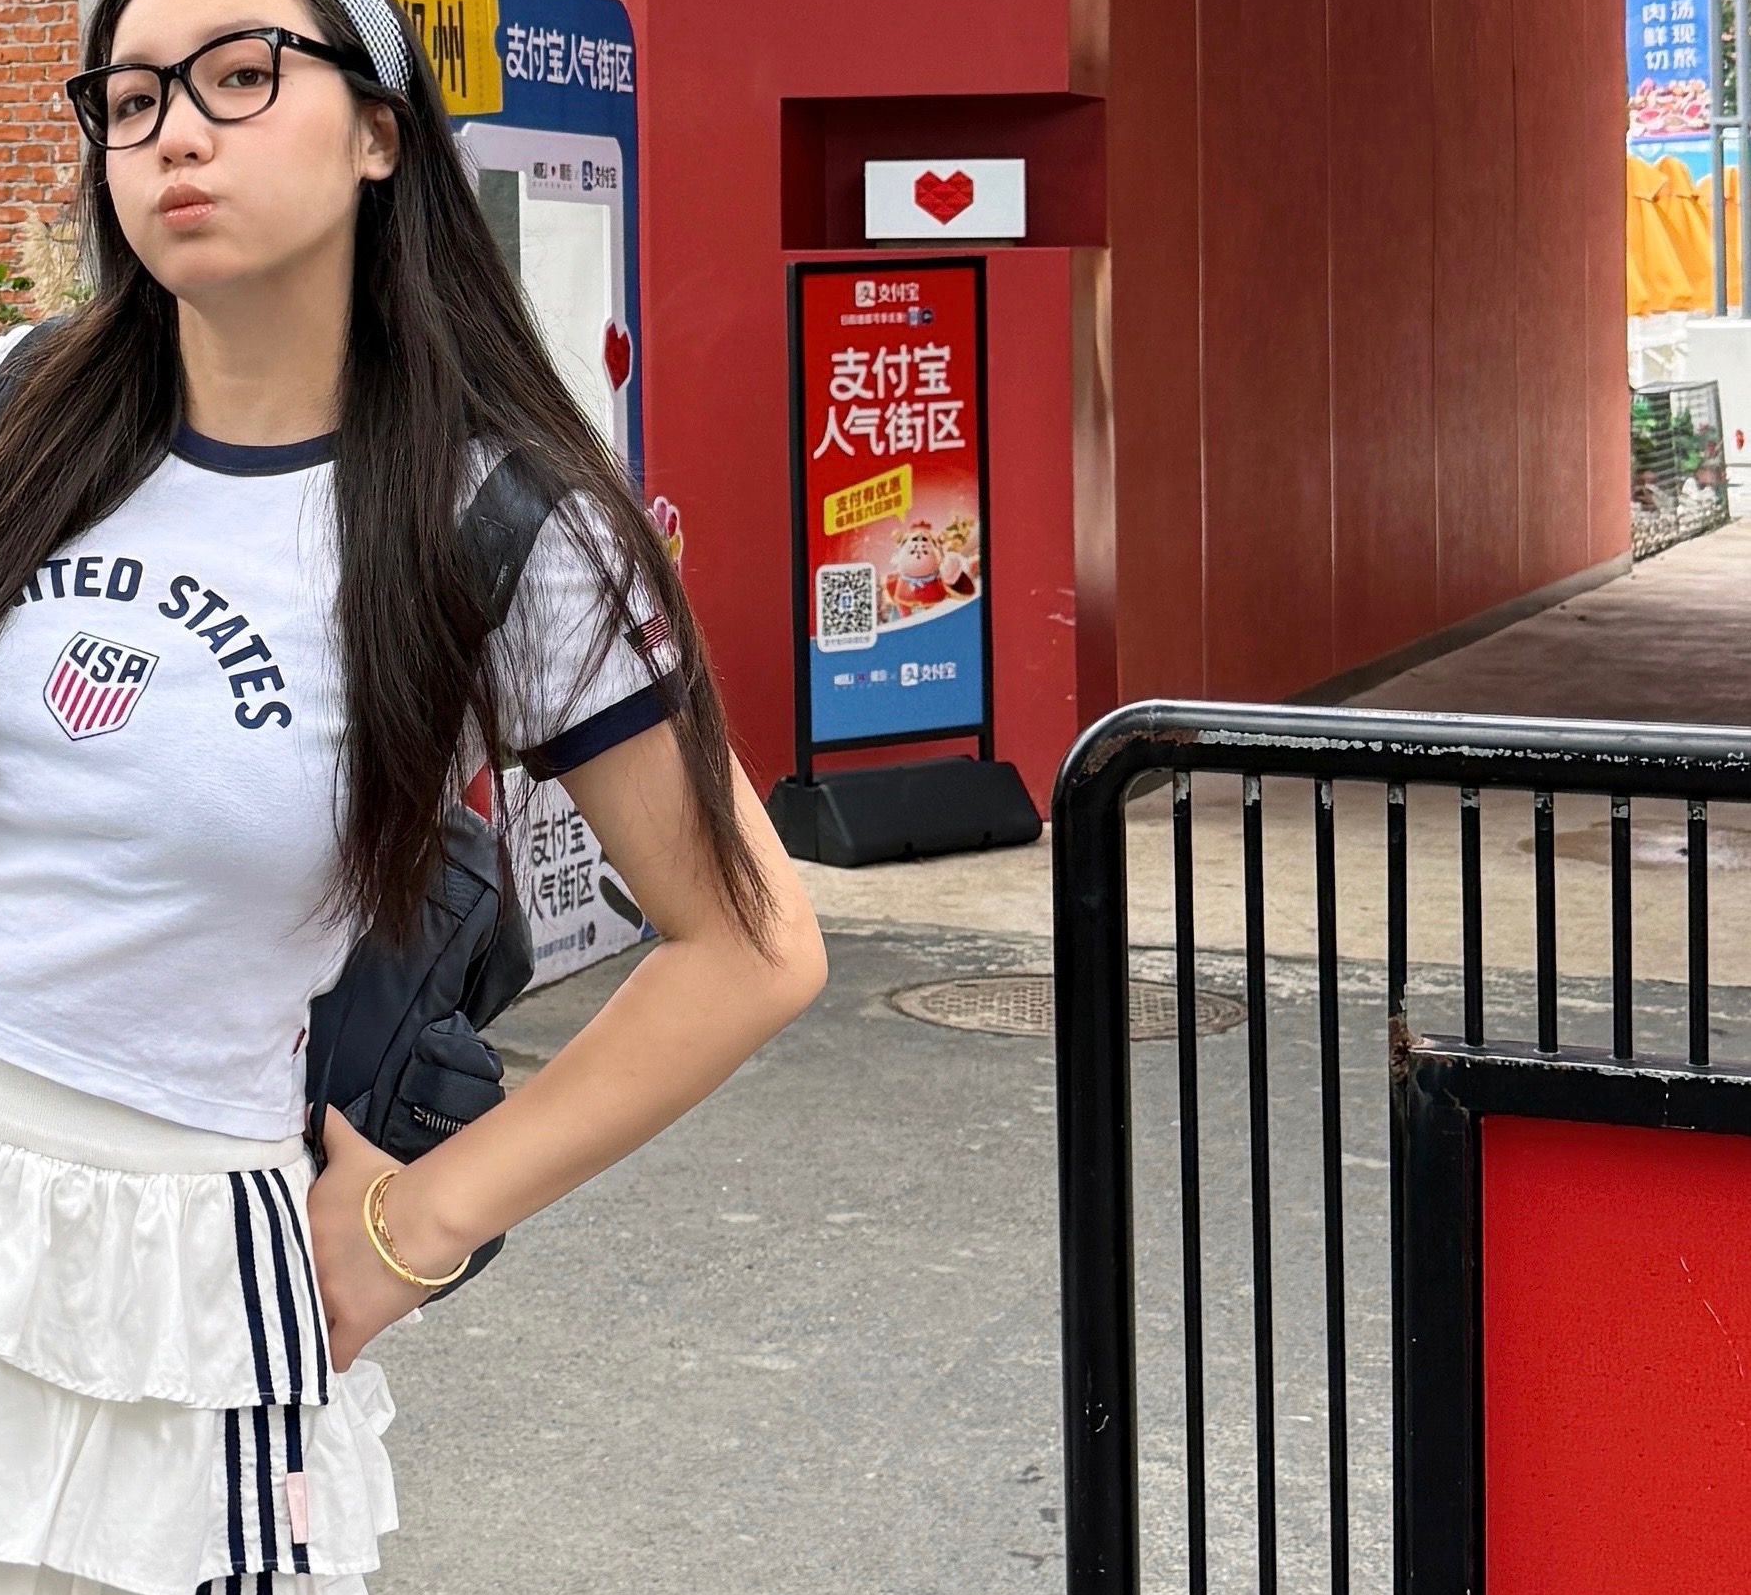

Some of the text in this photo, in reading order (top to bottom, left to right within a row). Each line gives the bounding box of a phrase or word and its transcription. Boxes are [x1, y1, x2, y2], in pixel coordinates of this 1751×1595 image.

[404, 0, 467, 98] 州
[505, 21, 635, 93] 支付宝人气街区
[829, 342, 952, 401] 支付宝
[813, 401, 966, 460] 人气街区
[13, 556, 292, 730] ITED STATES
[69, 638, 149, 684] USA
